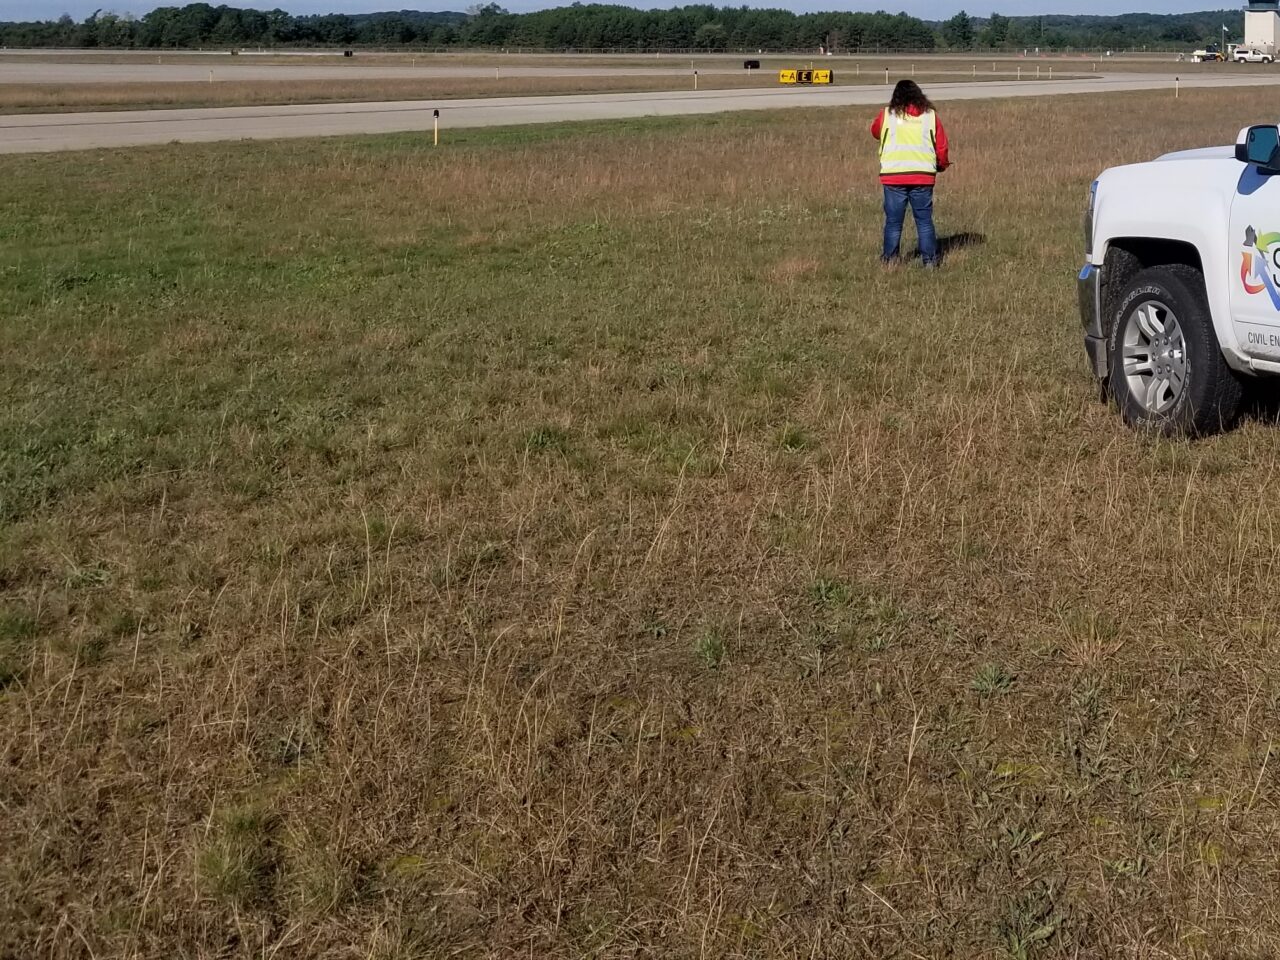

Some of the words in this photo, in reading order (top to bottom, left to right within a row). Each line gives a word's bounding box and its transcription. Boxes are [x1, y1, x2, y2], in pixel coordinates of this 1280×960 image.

[789, 72, 795, 80] A
[802, 72, 807, 80] E
[814, 72, 820, 80] A
[1247, 332, 1268, 346] CIVIL
